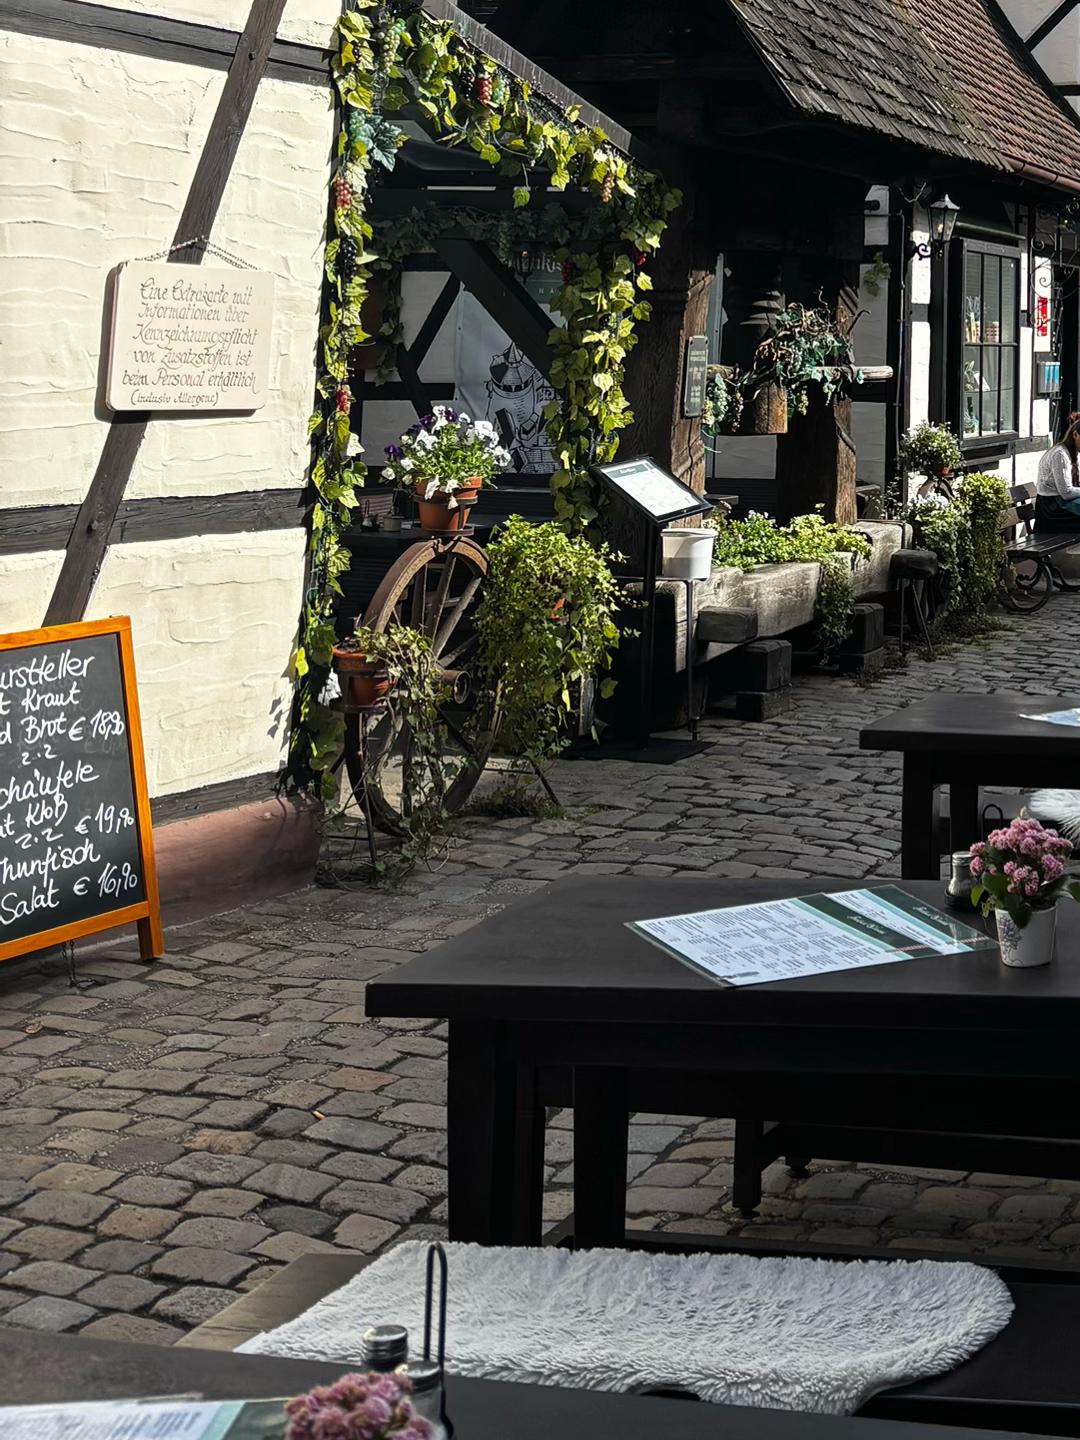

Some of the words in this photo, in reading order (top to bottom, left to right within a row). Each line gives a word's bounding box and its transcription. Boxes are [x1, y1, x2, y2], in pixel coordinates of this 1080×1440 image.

[140, 277, 168, 300] Eine
[172, 279, 229, 307] Extrakarte
[232, 286, 253, 305] mit
[138, 301, 220, 321] Informationen
[224, 305, 249, 323] über
[132, 321, 258, 351] Kennzeichnungspflicht
[133, 350, 156, 363] von
[157, 346, 231, 372] Zusatzstoffen
[235, 349, 252, 366] ist
[122, 369, 150, 386] beim
[151, 367, 206, 387] Personal
[207, 370, 260, 395] erhältlich
[21, 681, 80, 714] Kraut
[20, 712, 67, 744] Brot
[68, 716, 86, 741] €
[25, 793, 68, 828] Kloß
[74, 815, 91, 834] €
[94, 802, 135, 834] 19,90
[0, 838, 101, 888] hunfisch
[0, 878, 60, 925] Salat
[73, 876, 90, 895] €
[97, 862, 138, 898] 16,90
